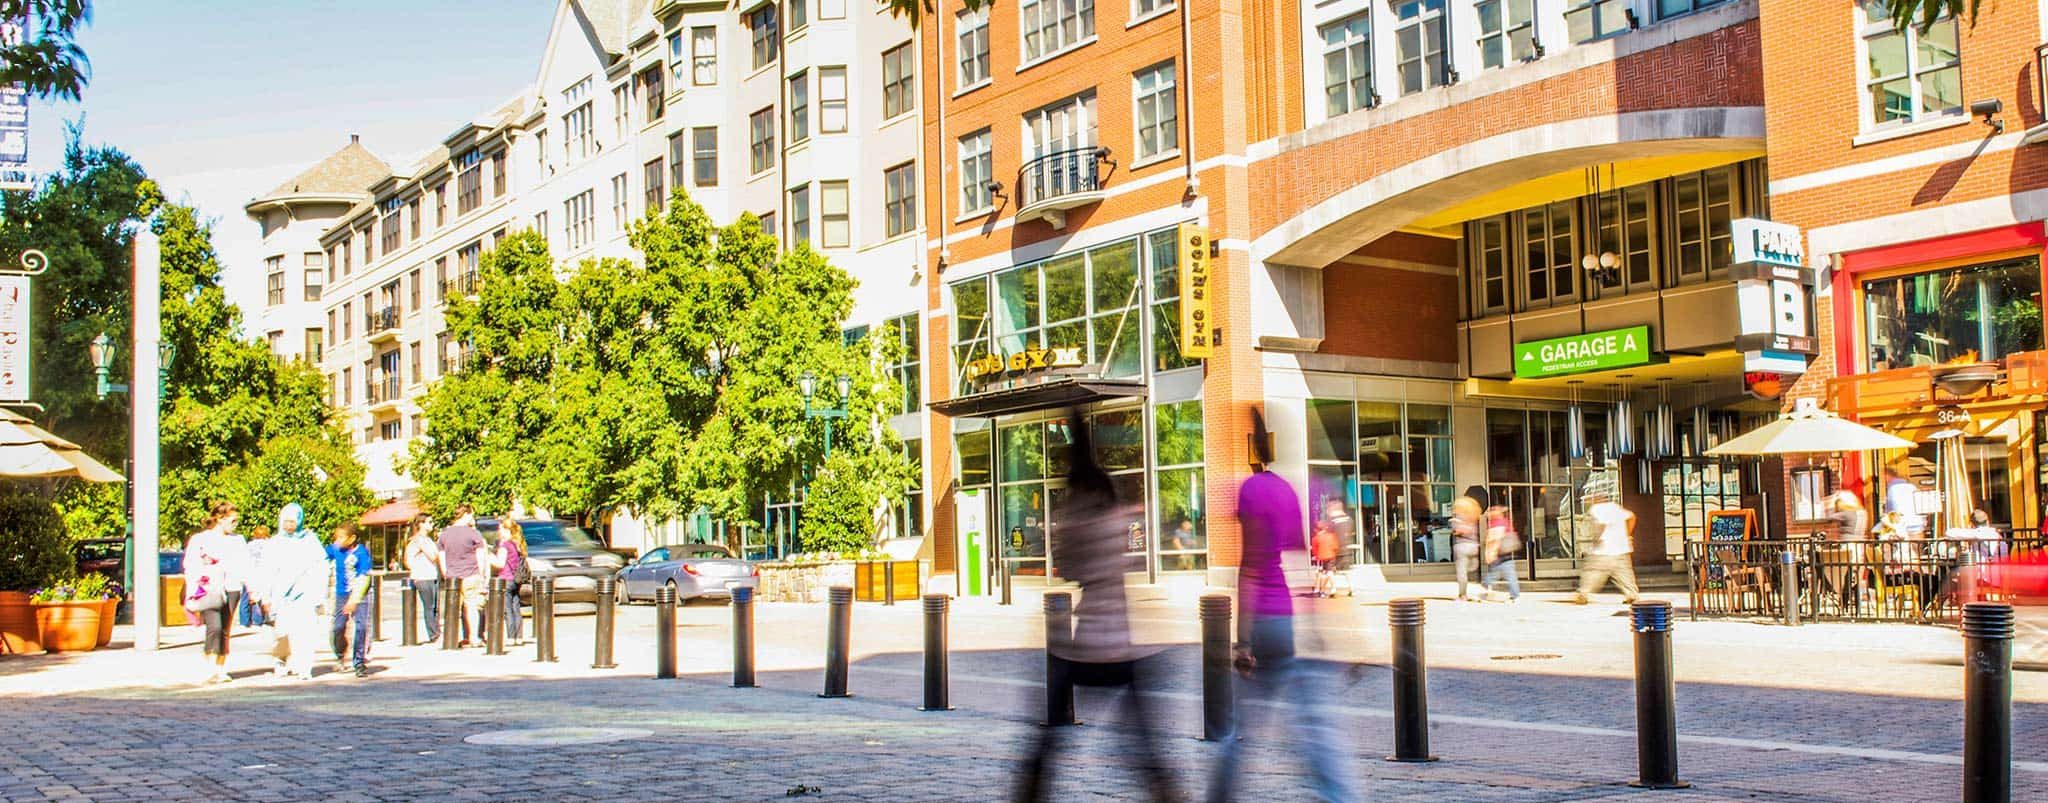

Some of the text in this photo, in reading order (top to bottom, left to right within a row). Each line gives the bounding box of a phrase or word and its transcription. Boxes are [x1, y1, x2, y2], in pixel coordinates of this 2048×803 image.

[1753, 229, 1804, 264] PARK
[1774, 279, 1806, 337] B
[1009, 347, 1082, 371] GYM
[1541, 333, 1637, 362] GARAGE A
[1938, 409, 1971, 424] 36-A
